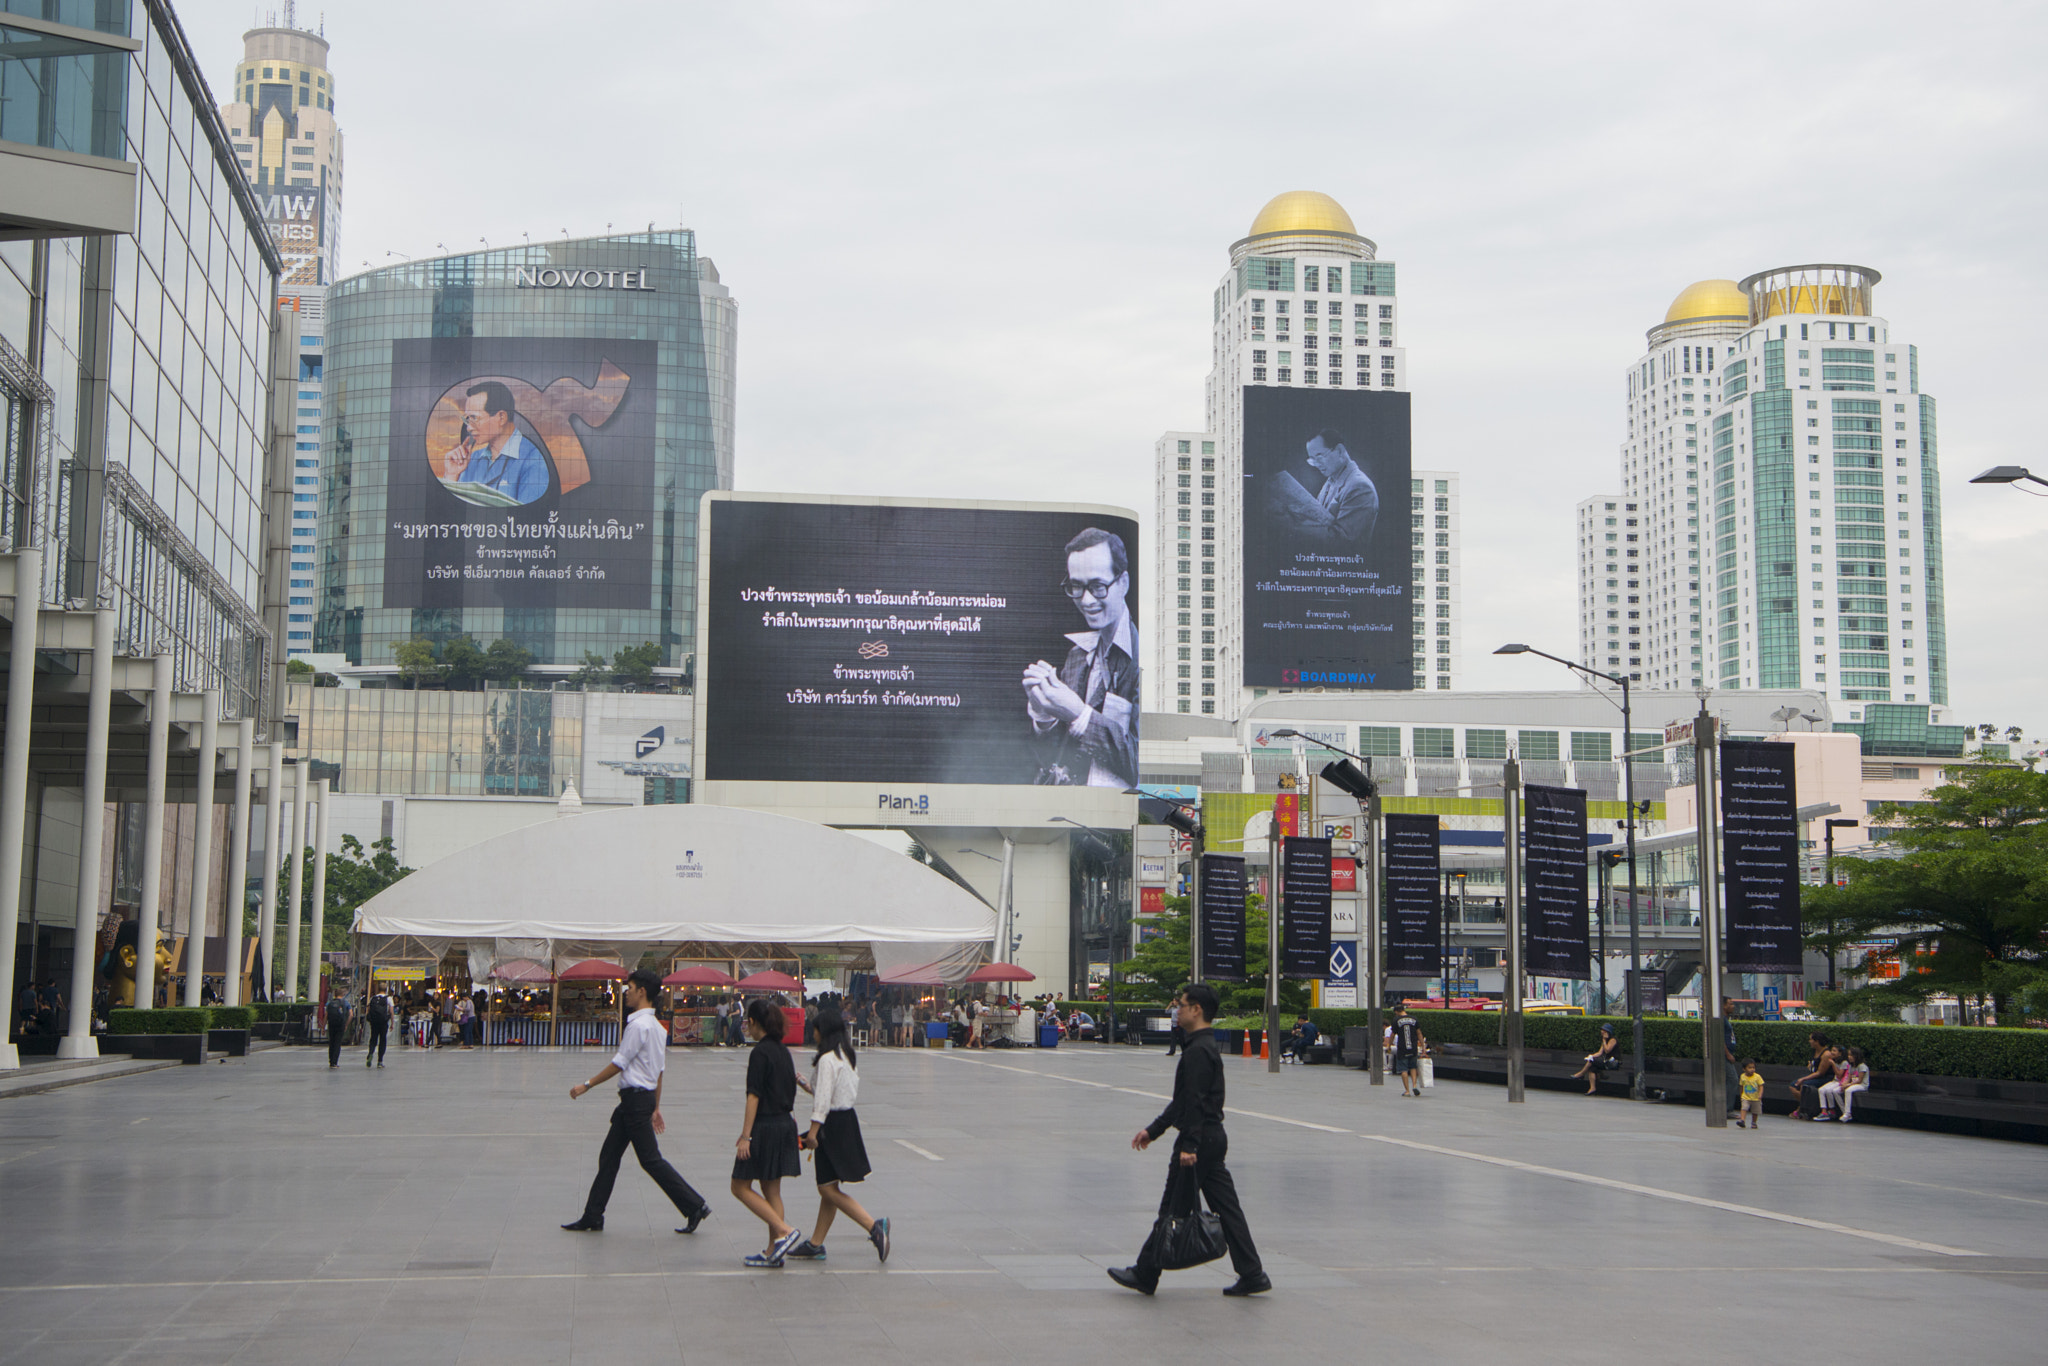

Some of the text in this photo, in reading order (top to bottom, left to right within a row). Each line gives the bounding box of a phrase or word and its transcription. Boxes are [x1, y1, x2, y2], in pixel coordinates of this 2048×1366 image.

[258, 194, 316, 220] MW
[263, 222, 314, 240] RIES
[515, 264, 656, 291] NOVOTEL
[476, 545, 556, 563] ข้าพระพุทธเจ้า
[1295, 553, 1364, 566] ปวงข้าพระพุทธเจ้า
[427, 565, 459, 580] บริษัท
[464, 563, 525, 580] ซีเอ็มวายเค
[576, 566, 606, 580] จำกัด
[740, 586, 1007, 609] ปวงข้าพระพุทธเจ้า ขอน้อมเกล้าน้อมกระหม่อม
[762, 611, 982, 636] รำลึกในพระมหากรุณาธิคุณหาที่สุดมิได้
[833, 663, 915, 684] ข้าพระพุทธเจ้า
[1300, 671, 1376, 684] BOARDWAY
[786, 688, 961, 707] บริษัท คาร์มาร์ท จำกัด(มหาชน)
[1324, 825, 1354, 839] B2S
[1332, 912, 1354, 921] ARA
